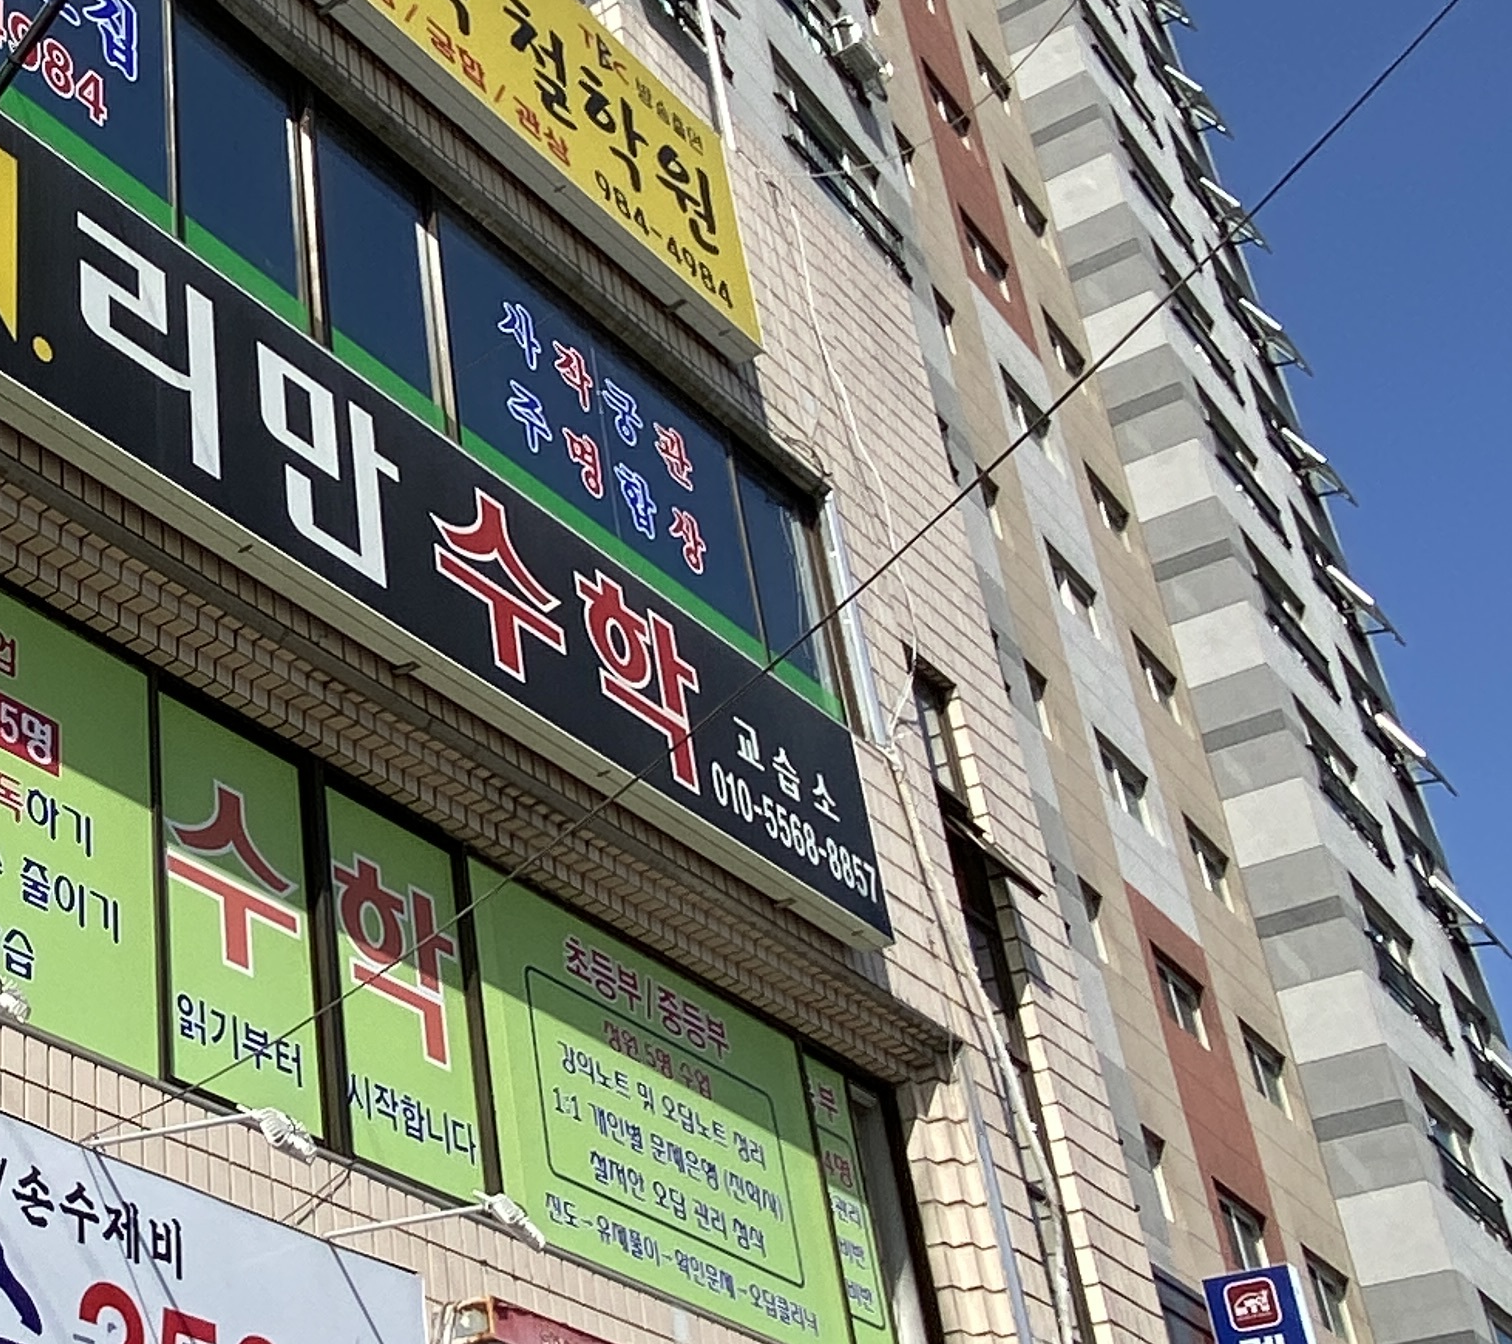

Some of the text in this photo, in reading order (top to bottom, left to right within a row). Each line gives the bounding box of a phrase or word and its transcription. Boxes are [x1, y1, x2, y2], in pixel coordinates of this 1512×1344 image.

[426, 16, 487, 94] 궁합
[513, 95, 571, 167] 관상
[594, 169, 733, 309] 984-4984
[75, 209, 703, 797] 리만 수학
[733, 716, 841, 822] 교습소
[711, 761, 878, 904] 010-5568-8857
[20, 855, 120, 944] 줄이기
[165, 779, 461, 1071] 수학
[176, 992, 304, 1089] 읽기부터
[563, 935, 731, 1060] 초등부 중등부
[346, 1072, 478, 1166] 시작합니다
[552, 1086, 582, 1122] 1:1
[588, 1102, 644, 1154] 개인별
[649, 1131, 720, 1192] 문제은행
[557, 1040, 631, 1100] 강의노트
[662, 1094, 729, 1148] 오답노트
[652, 1180, 688, 1222] 오답
